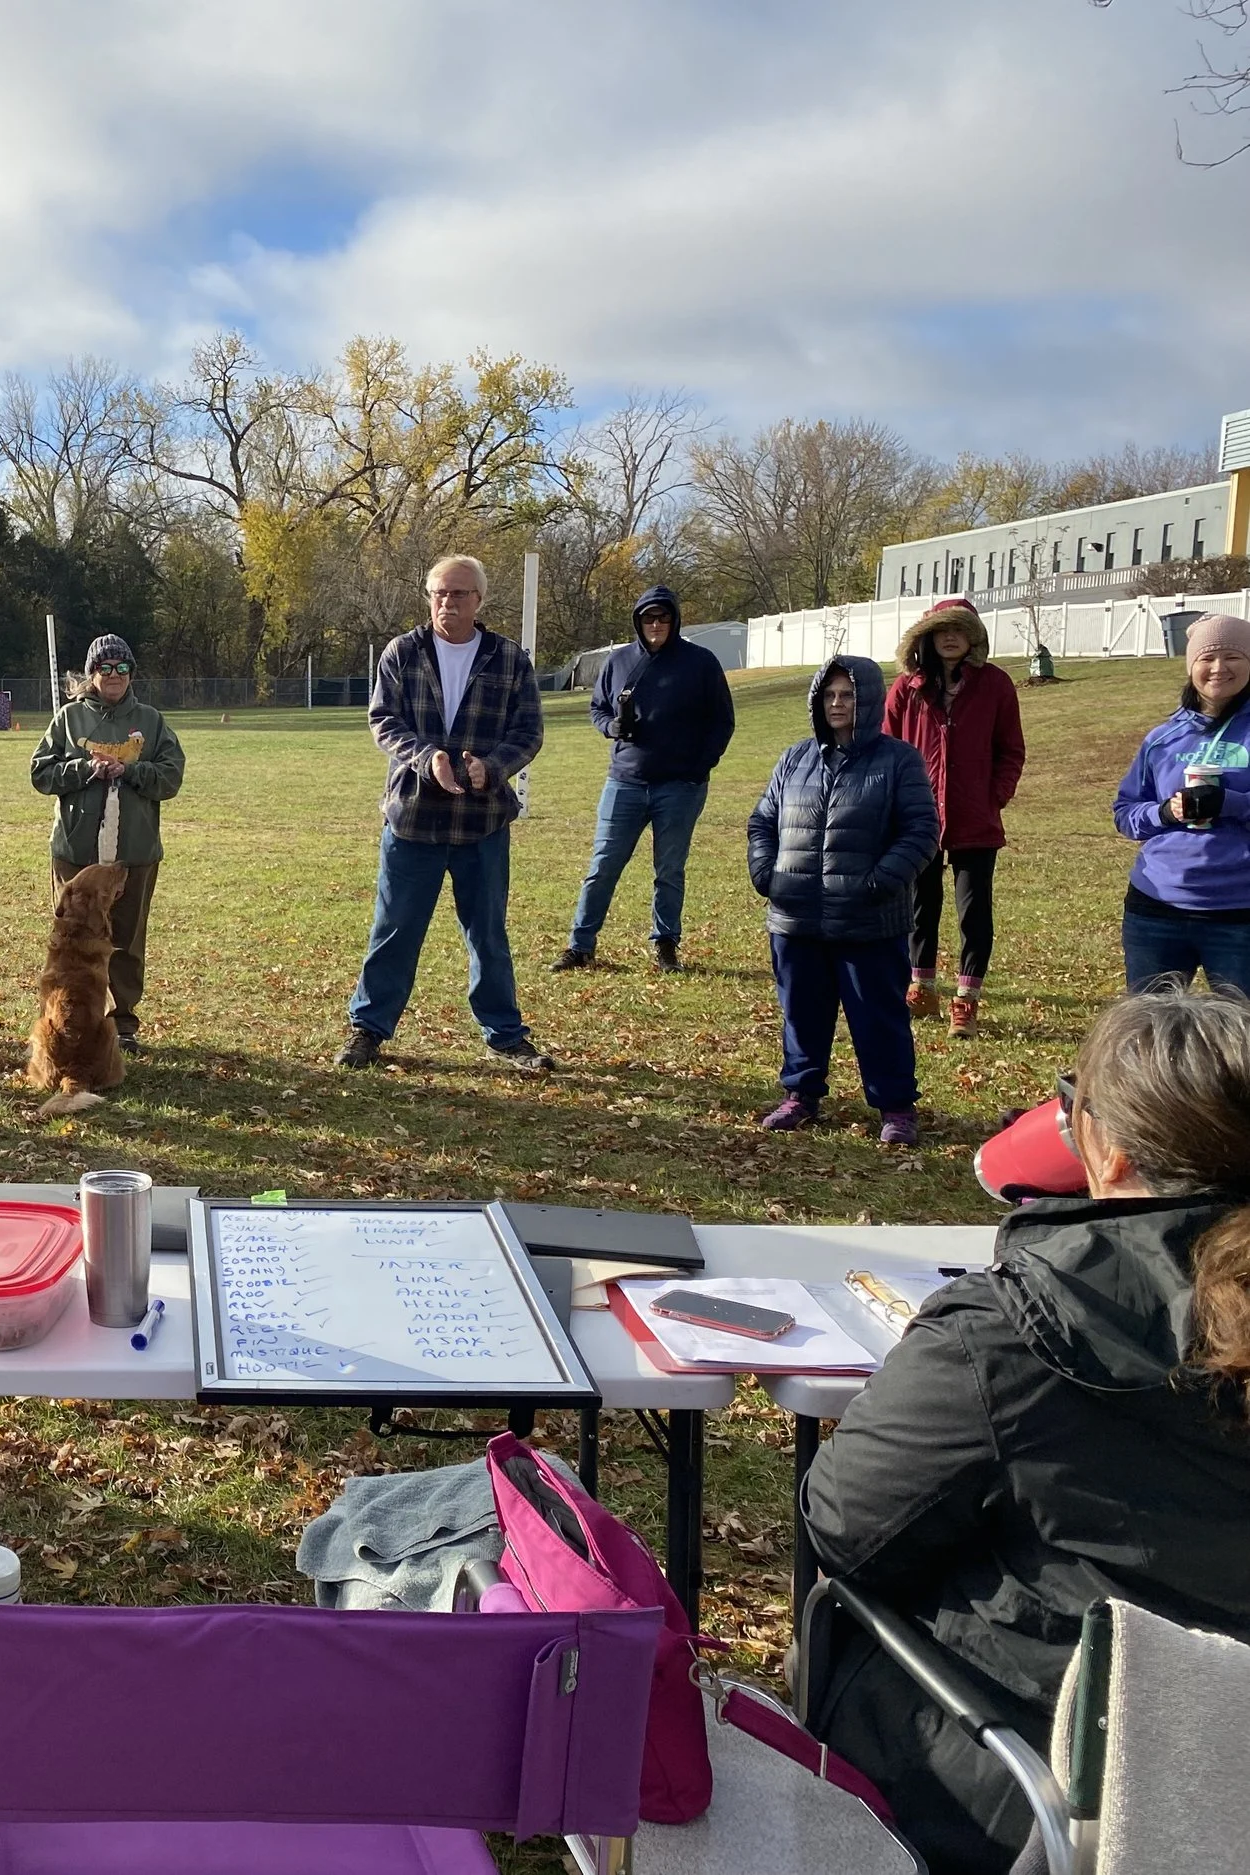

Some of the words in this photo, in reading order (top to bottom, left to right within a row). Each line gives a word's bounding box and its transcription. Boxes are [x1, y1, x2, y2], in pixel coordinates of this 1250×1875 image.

[364, 1238, 415, 1246] LUNA
[219, 1245, 288, 1255] SPLASH
[220, 1256, 280, 1265] COSMO
[379, 1261, 471, 1270] INTER
[222, 1265, 286, 1277] SONNY
[221, 1278, 297, 1288] SCOOBIE
[395, 1275, 453, 1285] LINK
[229, 1290, 265, 1299] ROO
[396, 1287, 480, 1297] ARCHIE
[403, 1300, 462, 1309] HELO
[229, 1312, 297, 1322] CAPER
[412, 1313, 479, 1321] NADA
[229, 1323, 306, 1335] REESE
[407, 1325, 504, 1335] WICKET
[236, 1335, 279, 1348] FIN
[414, 1337, 486, 1347] AJAX
[230, 1346, 330, 1358] MYSTIQUE
[421, 1348, 498, 1358] ROGER
[237, 1360, 323, 1374] HOOTIE
